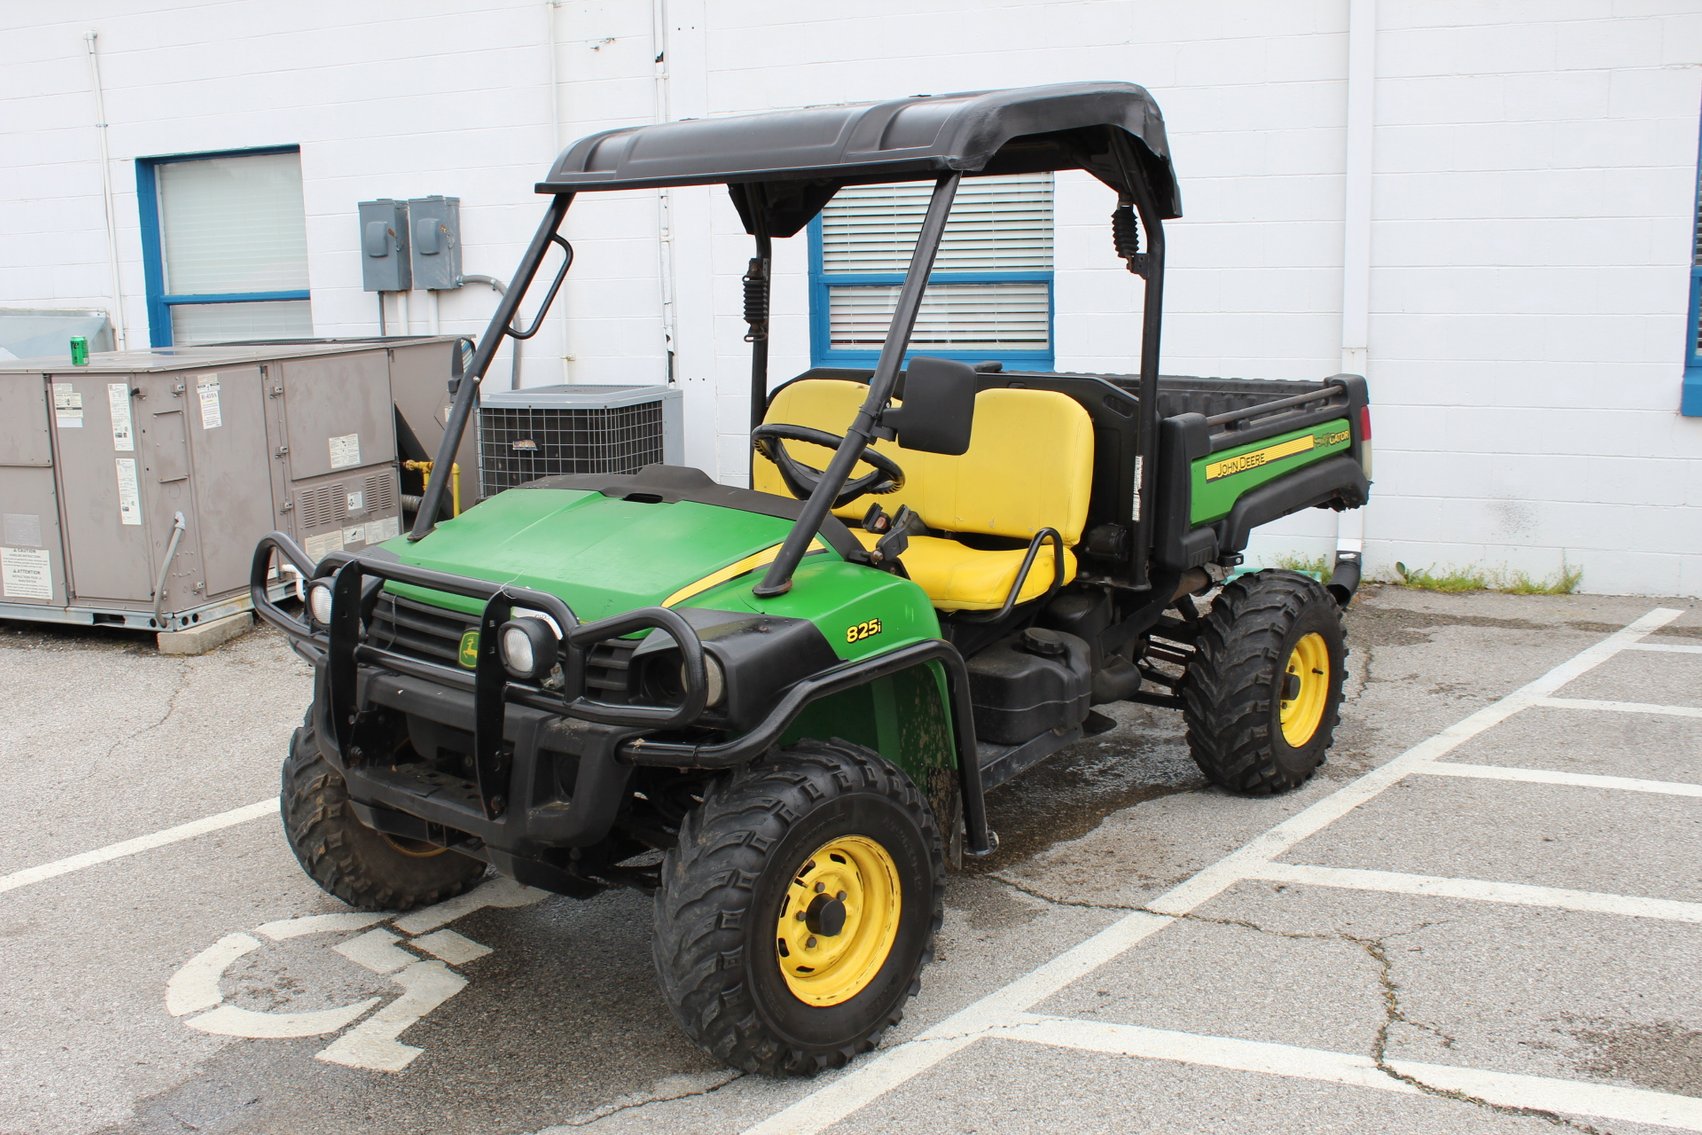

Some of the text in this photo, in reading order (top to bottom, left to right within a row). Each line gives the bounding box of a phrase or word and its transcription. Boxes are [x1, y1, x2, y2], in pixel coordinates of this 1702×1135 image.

[1329, 430, 1349, 444] GATOR
[1217, 453, 1266, 478] JOHN DEERE
[846, 618, 882, 643] 825i
